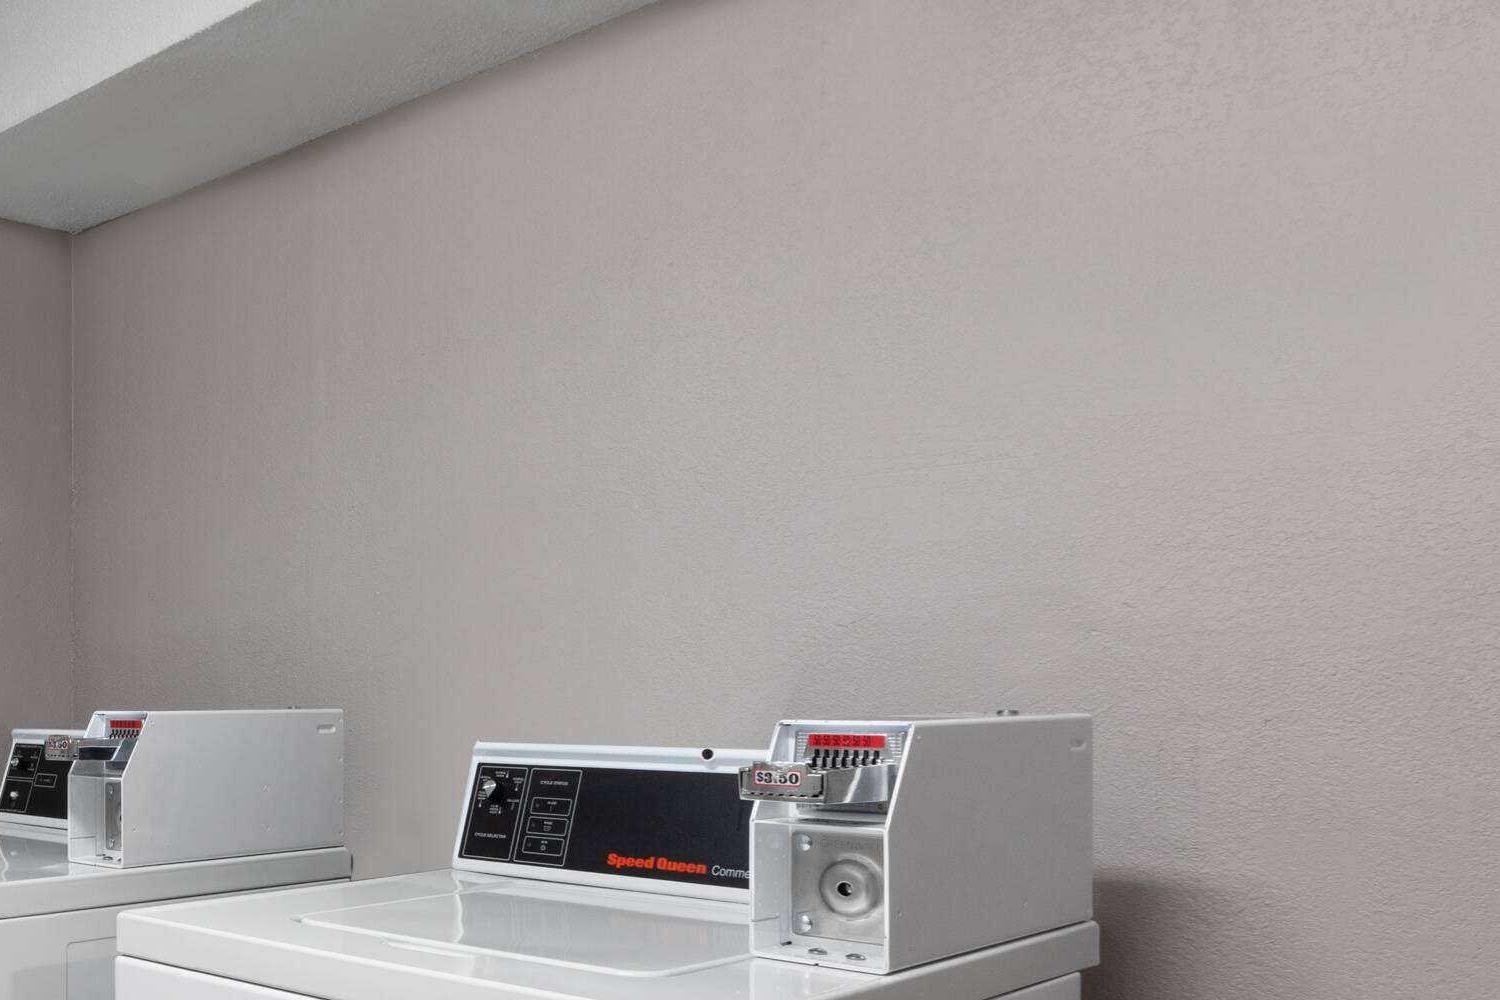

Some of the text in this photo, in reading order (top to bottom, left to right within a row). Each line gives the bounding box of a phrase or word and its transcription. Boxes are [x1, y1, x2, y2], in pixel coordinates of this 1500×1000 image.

[755, 771, 800, 785] $3.50
[606, 852, 655, 869] Speed
[656, 856, 708, 875] Queen
